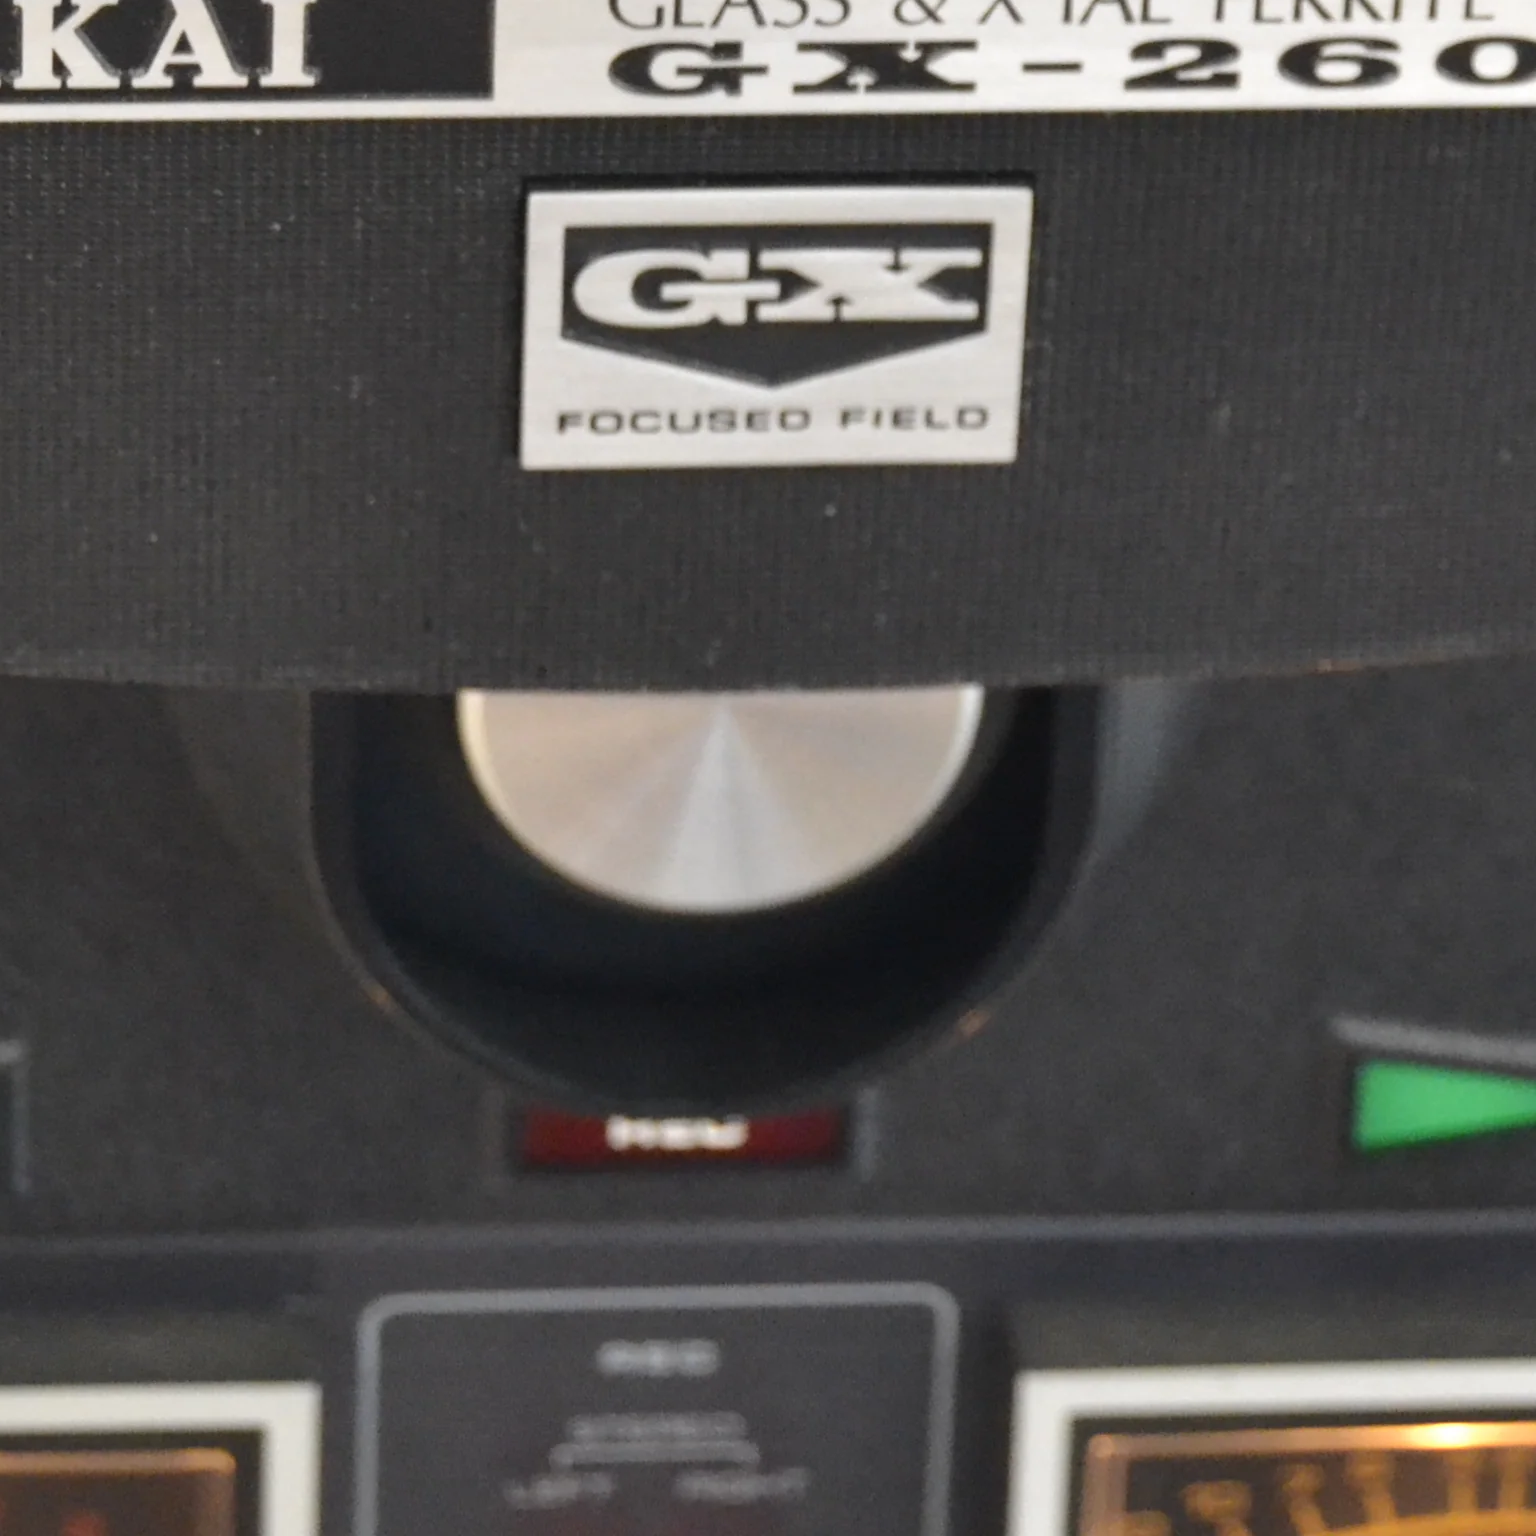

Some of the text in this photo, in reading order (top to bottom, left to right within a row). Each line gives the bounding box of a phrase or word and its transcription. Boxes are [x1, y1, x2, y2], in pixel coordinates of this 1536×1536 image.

[572, 246, 984, 328] GX
[556, 405, 990, 435] FOCUSED FIELD
